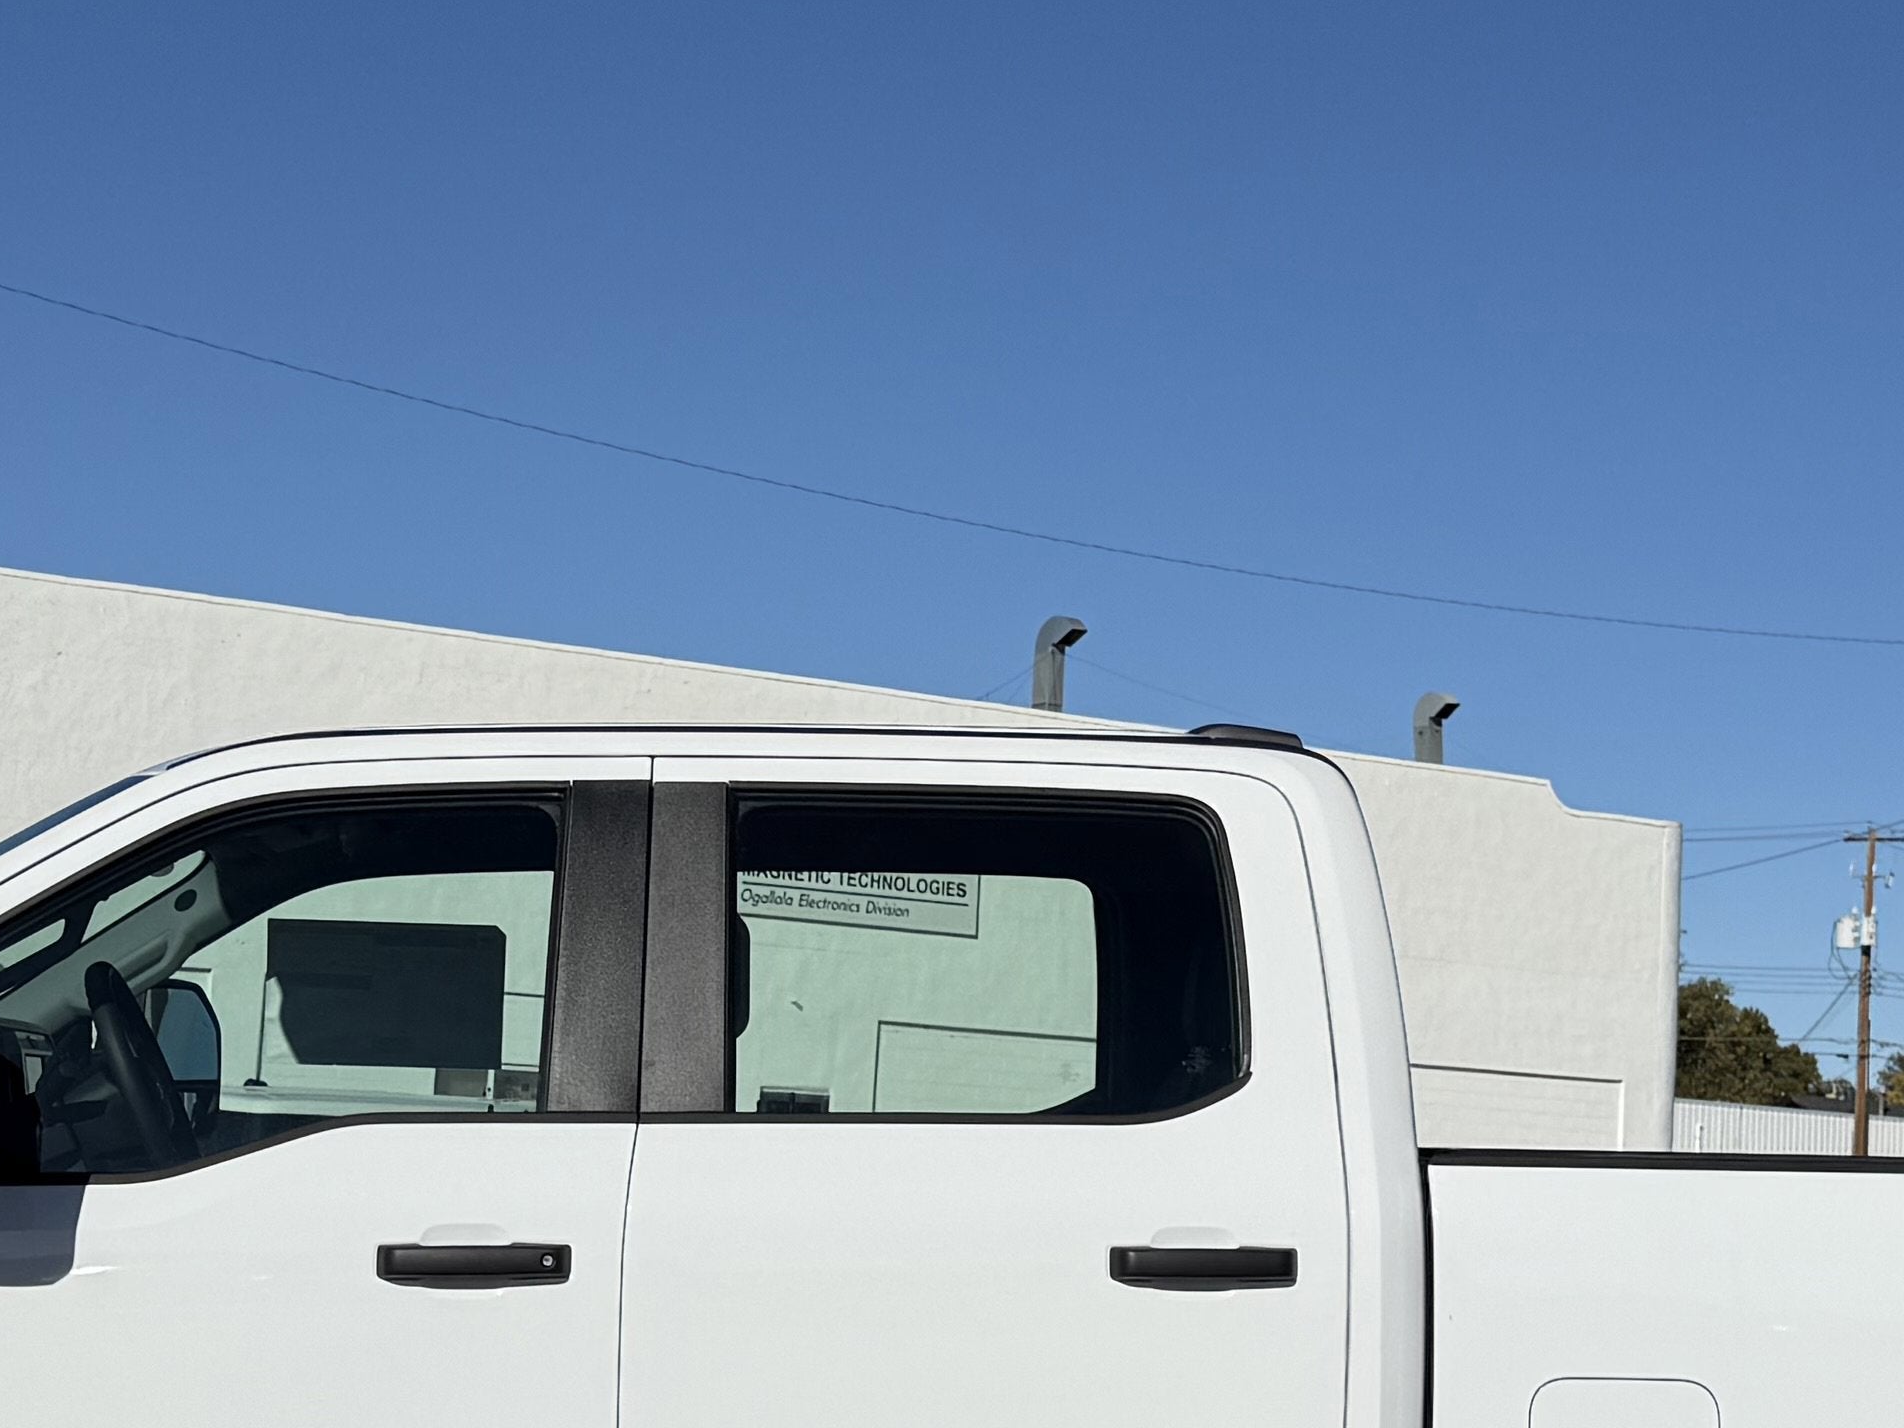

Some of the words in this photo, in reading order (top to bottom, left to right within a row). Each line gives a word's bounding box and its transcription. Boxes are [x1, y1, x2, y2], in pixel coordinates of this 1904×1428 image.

[838, 872, 968, 898] TECHNOLOGIES
[741, 888, 794, 907] Ogallala
[798, 893, 860, 913] Electronics
[865, 900, 910, 918] Division
